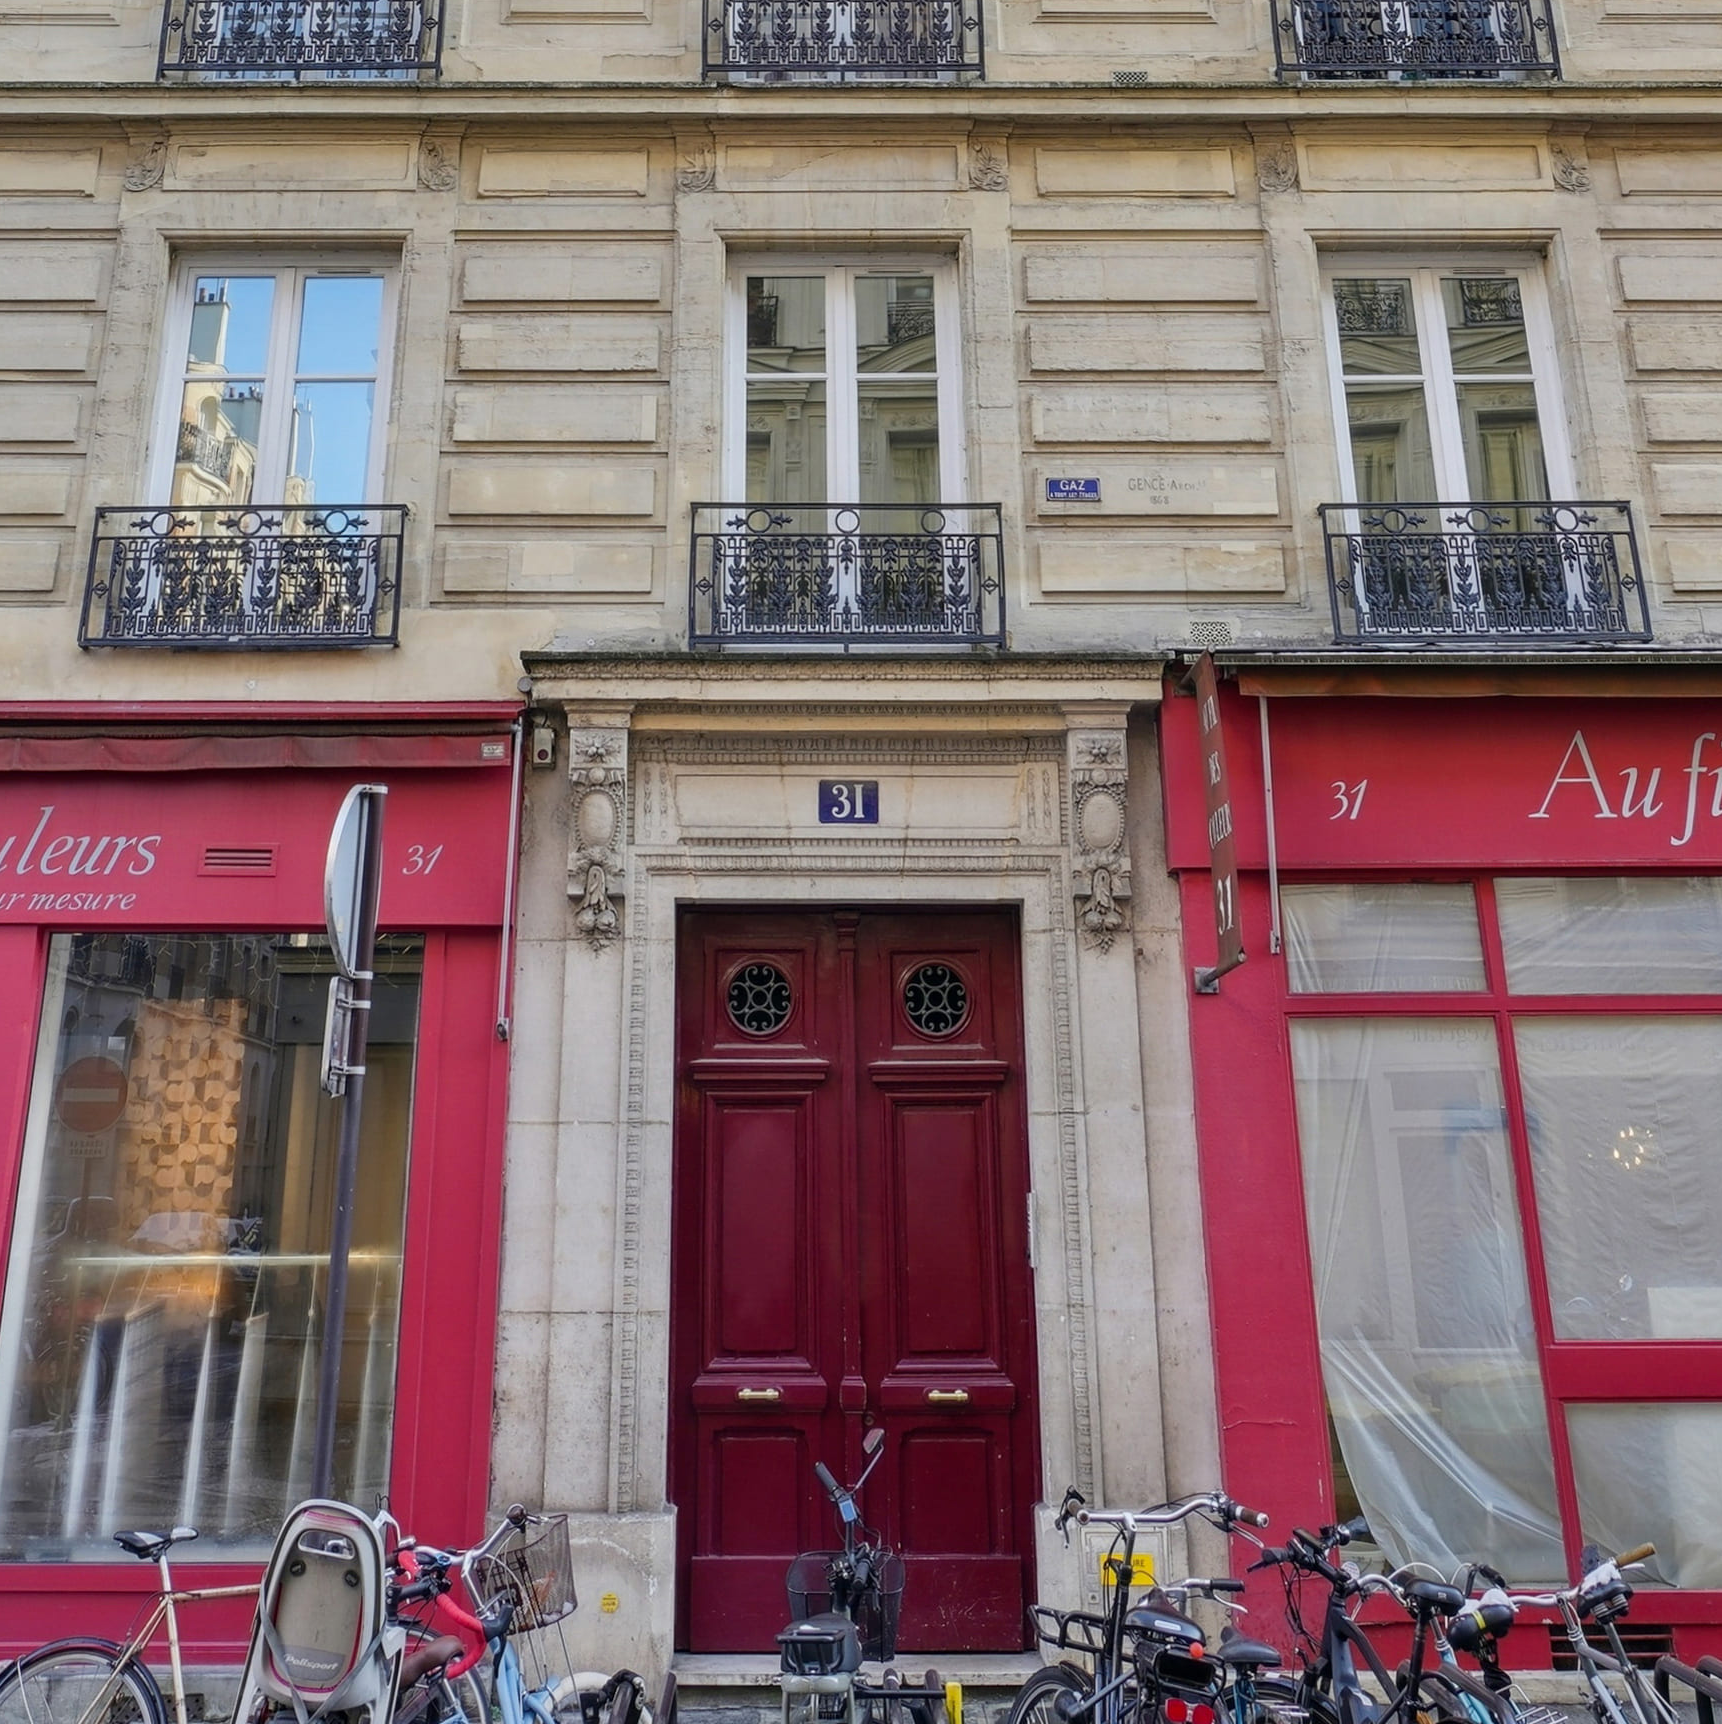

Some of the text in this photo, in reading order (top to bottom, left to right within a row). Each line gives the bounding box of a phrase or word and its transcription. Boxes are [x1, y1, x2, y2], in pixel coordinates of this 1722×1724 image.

[1060, 479, 1086, 491] GAZ
[1528, 737, 1663, 818] Au
[831, 784, 865, 819] 31
[1330, 779, 1368, 820] 31
[402, 844, 443, 875] 31
[27, 892, 137, 911] mesure
[1217, 874, 1234, 936] 31
[283, 1652, 339, 1671] Polisport
